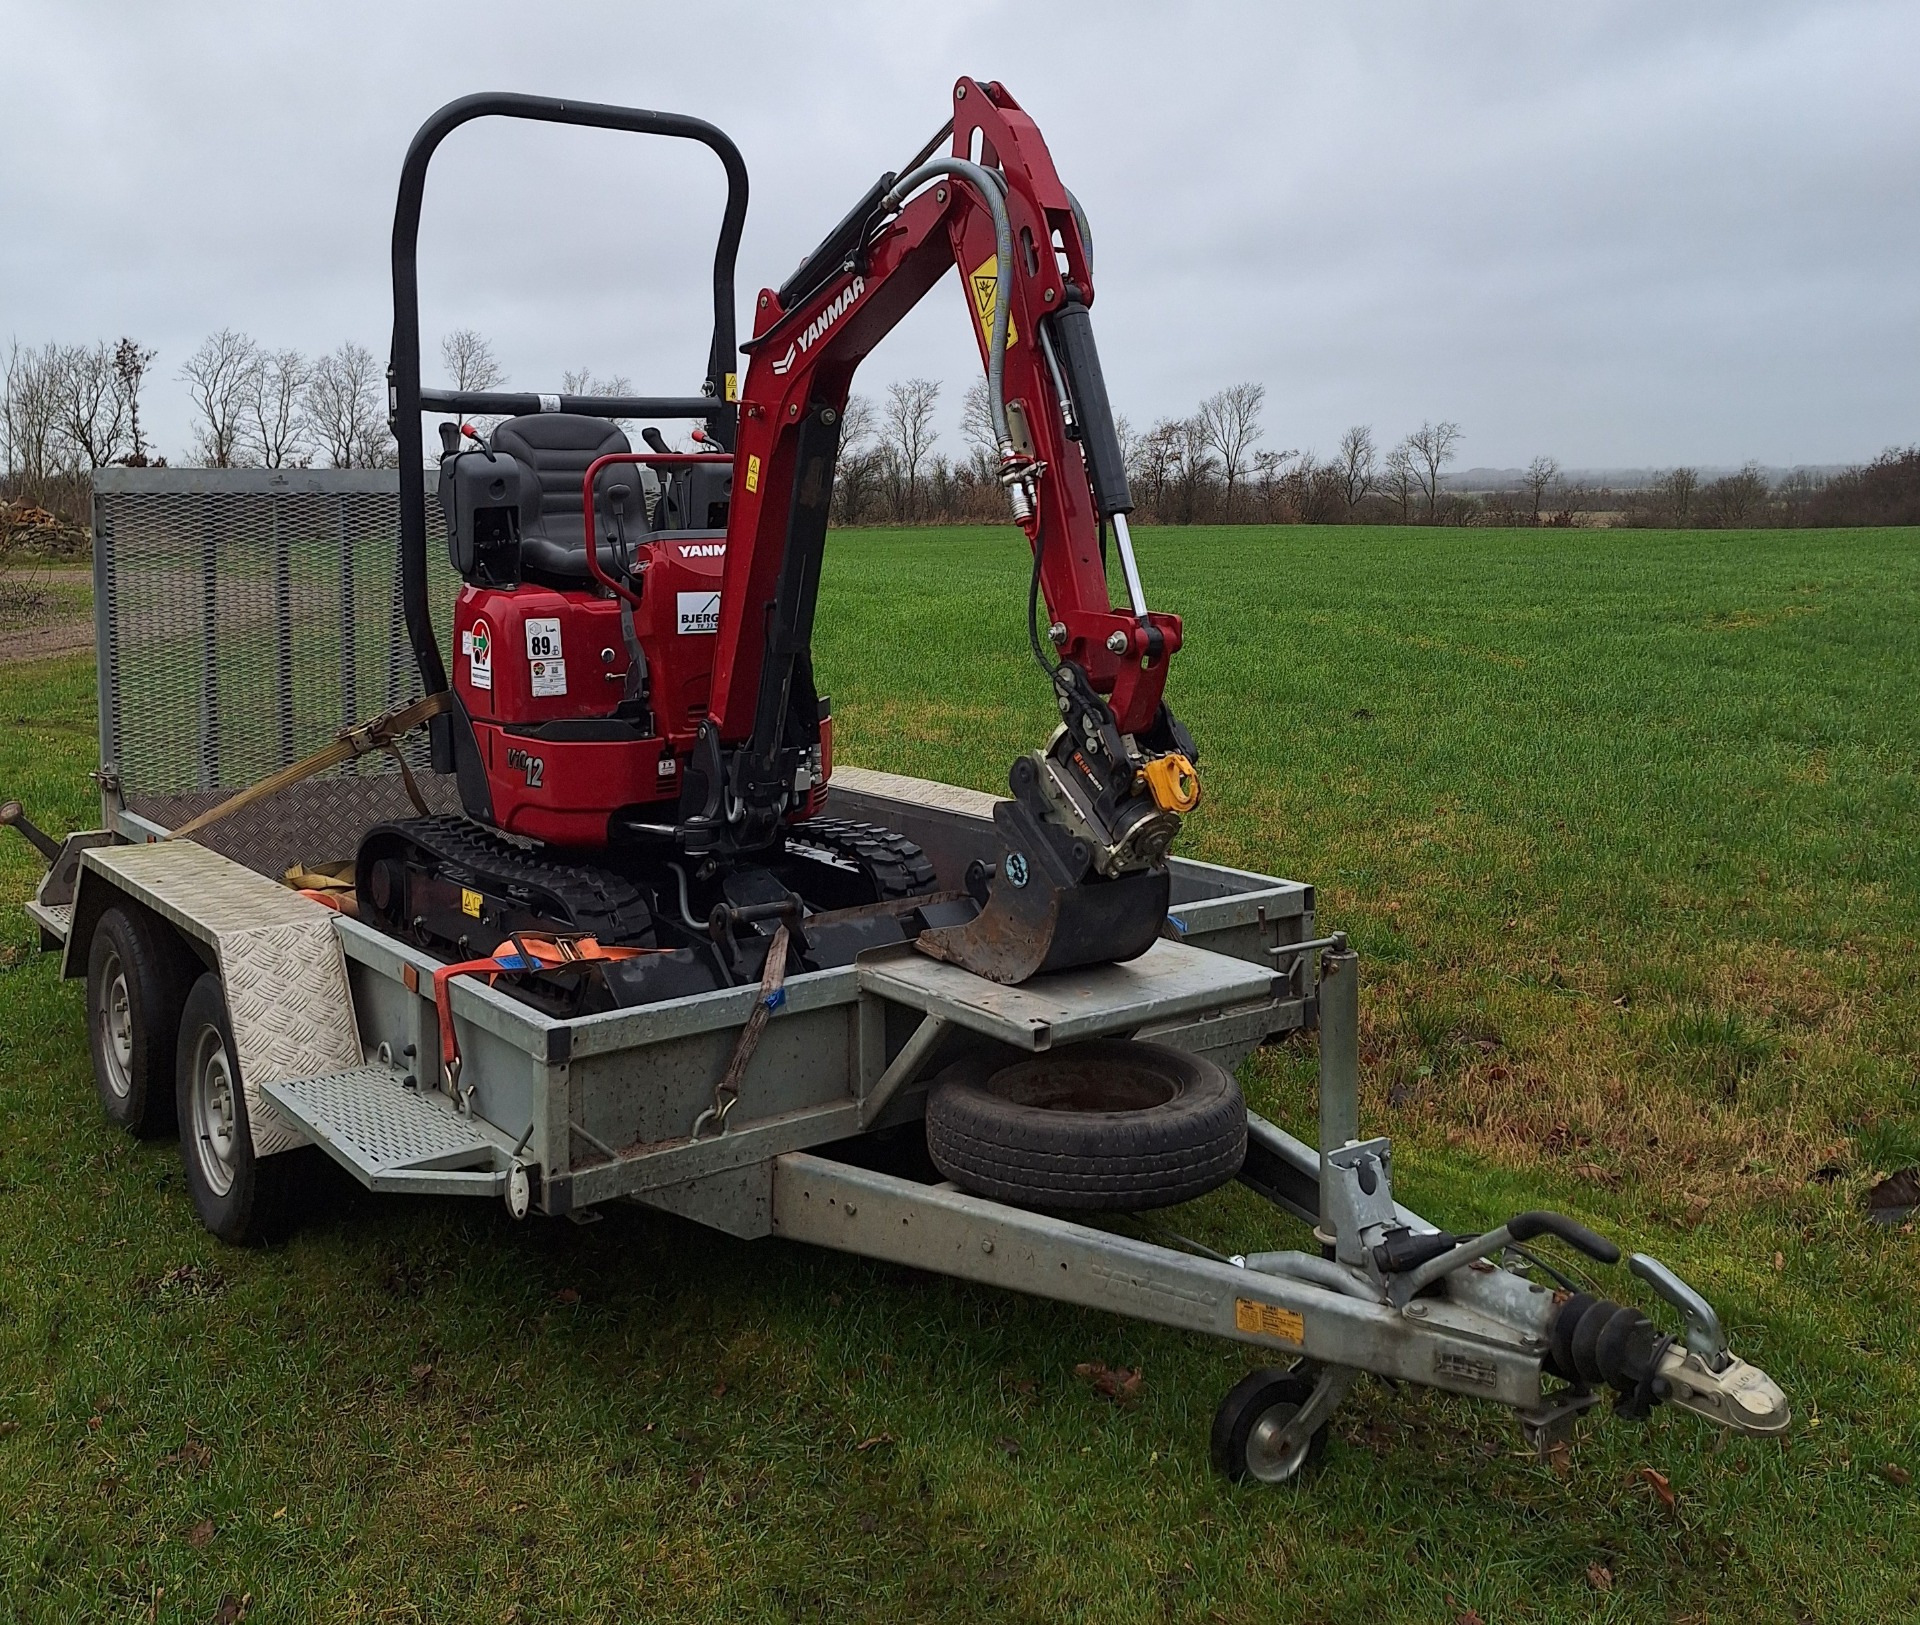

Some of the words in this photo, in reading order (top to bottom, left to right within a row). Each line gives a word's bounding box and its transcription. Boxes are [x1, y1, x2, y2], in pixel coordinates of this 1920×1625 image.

[797, 275, 865, 353] YANMAR
[531, 636, 551, 656] 89
[526, 756, 544, 788] 12
